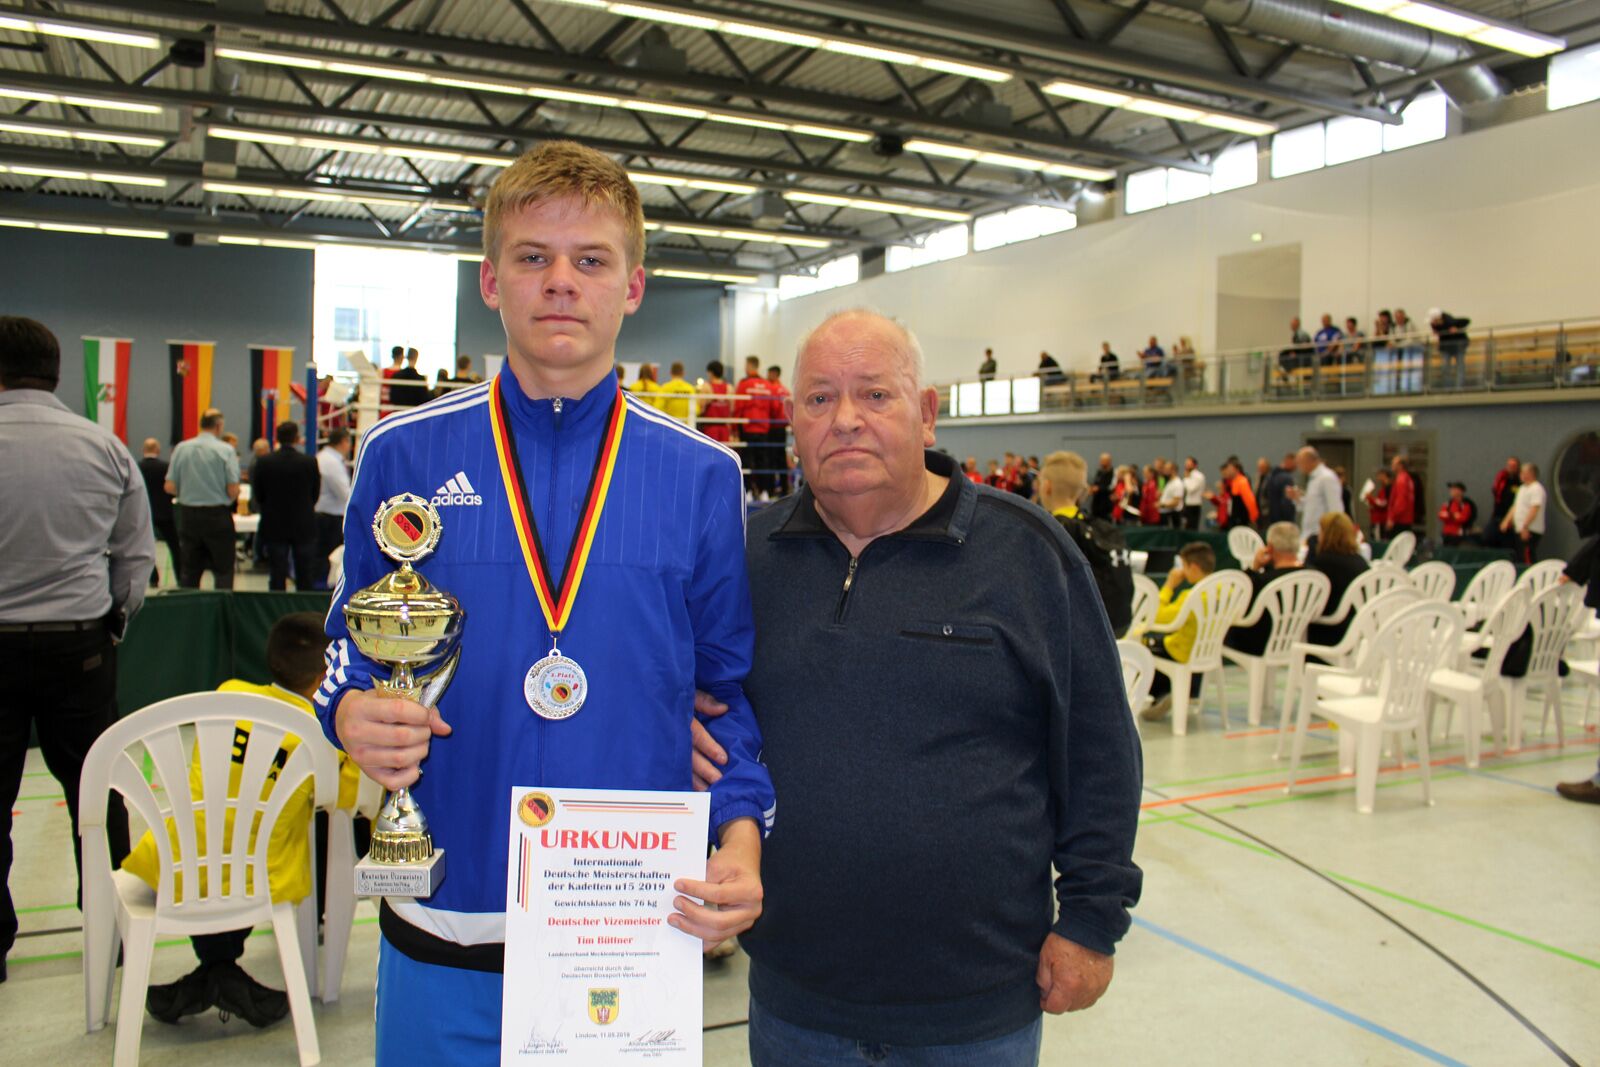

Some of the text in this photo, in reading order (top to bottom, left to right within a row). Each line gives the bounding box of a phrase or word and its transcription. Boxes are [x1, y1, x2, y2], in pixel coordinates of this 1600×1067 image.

[431, 492, 483, 506] adidas
[541, 829, 677, 850] URKUNDE
[573, 857, 643, 867] Internationale
[544, 870, 671, 879] Deutsche Meisterschaften
[548, 882, 666, 891] der Kadetten u15 2019
[554, 899, 658, 908] Gewichtsklasse bis 76 kg
[547, 917, 662, 926] Deutscher Vizemeister
[576, 936, 634, 945] Tim Büttner
